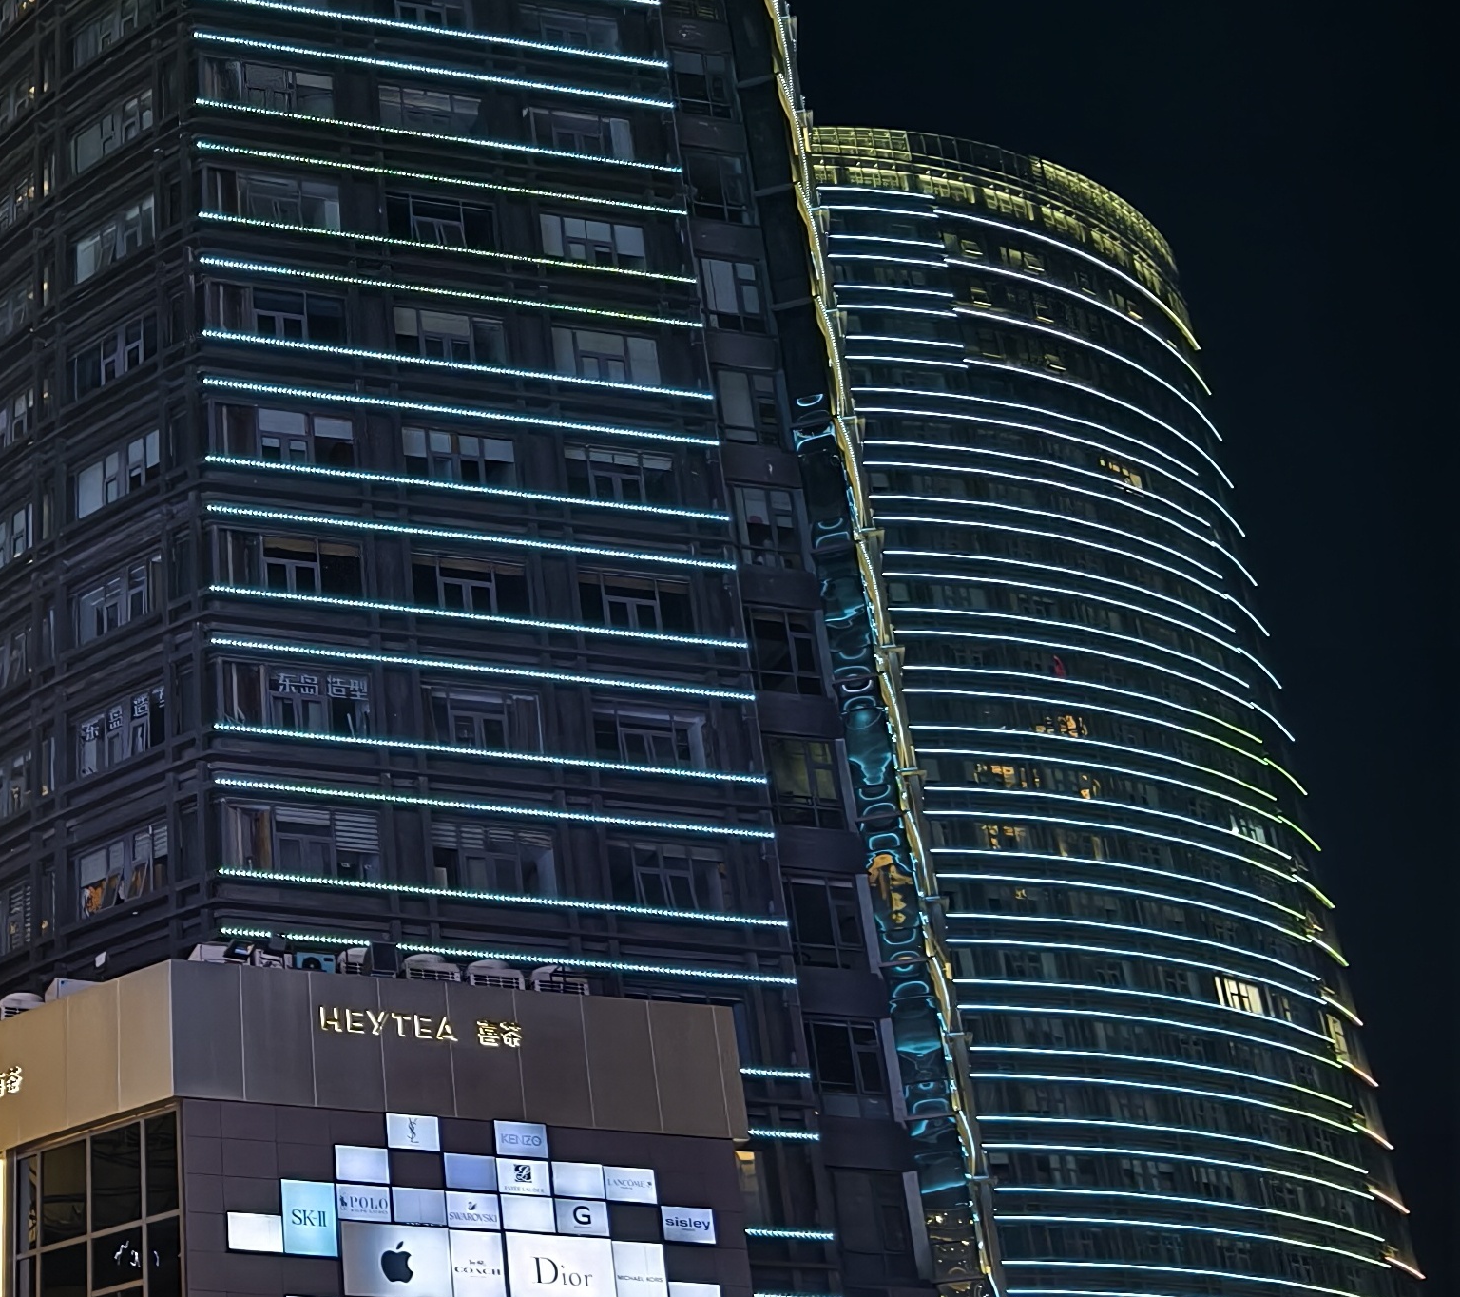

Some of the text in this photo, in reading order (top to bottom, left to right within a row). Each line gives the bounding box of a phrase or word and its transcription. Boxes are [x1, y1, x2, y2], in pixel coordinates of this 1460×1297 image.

[320, 1006, 459, 1042] HEYTEA
[500, 1132, 542, 1147] KENZO
[349, 1195, 389, 1211] POLO
[291, 1208, 327, 1228] SK-II
[449, 1211, 498, 1223] SWAROVSKI
[664, 1216, 711, 1231] sisley
[531, 1256, 593, 1287] Dior
